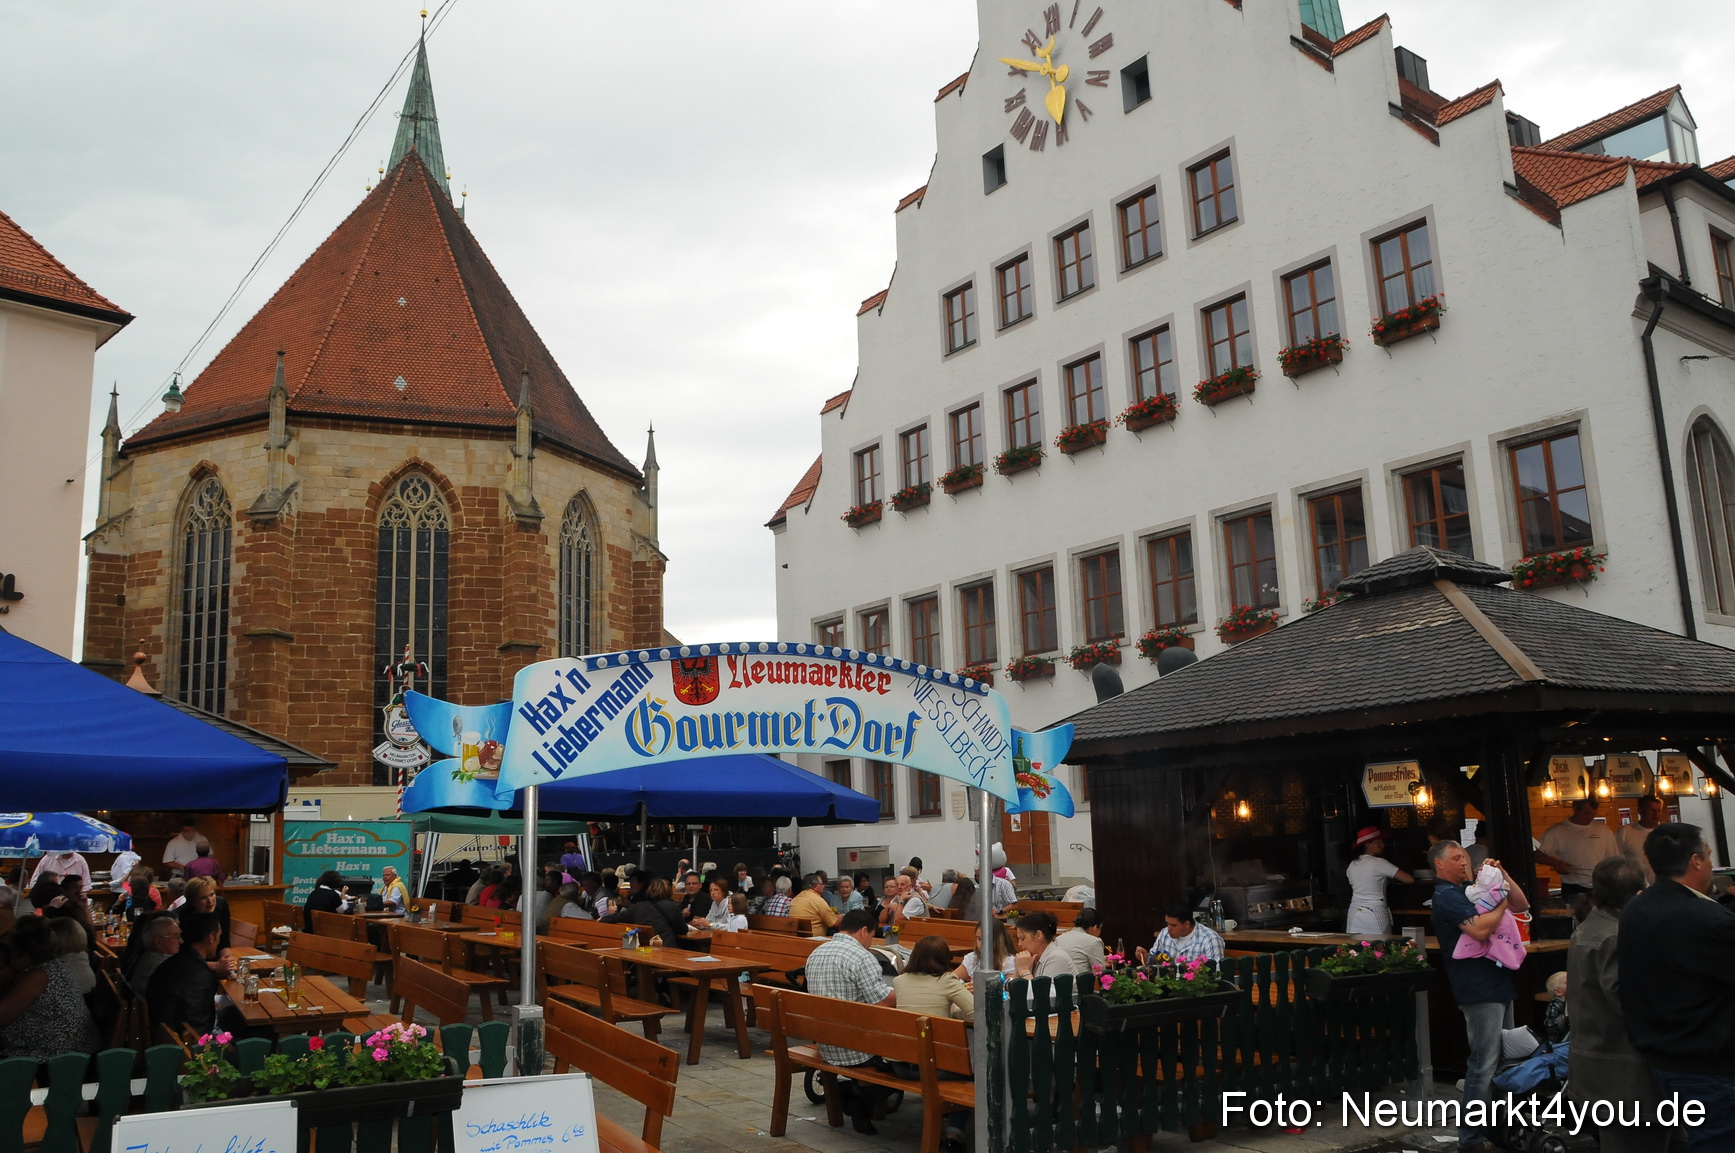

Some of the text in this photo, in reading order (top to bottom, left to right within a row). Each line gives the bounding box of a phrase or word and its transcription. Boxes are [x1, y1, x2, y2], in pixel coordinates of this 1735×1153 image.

[726, 654, 892, 695] Neumarkter
[518, 668, 592, 736] Hax'n
[531, 663, 655, 780] Liebermann
[907, 676, 997, 788] NIESSLBECK
[301, 843, 387, 855] Liebermann
[326, 833, 366, 844] Hax'n
[335, 861, 370, 871] Hax'n
[466, 1110, 553, 1138] Schaschlik
